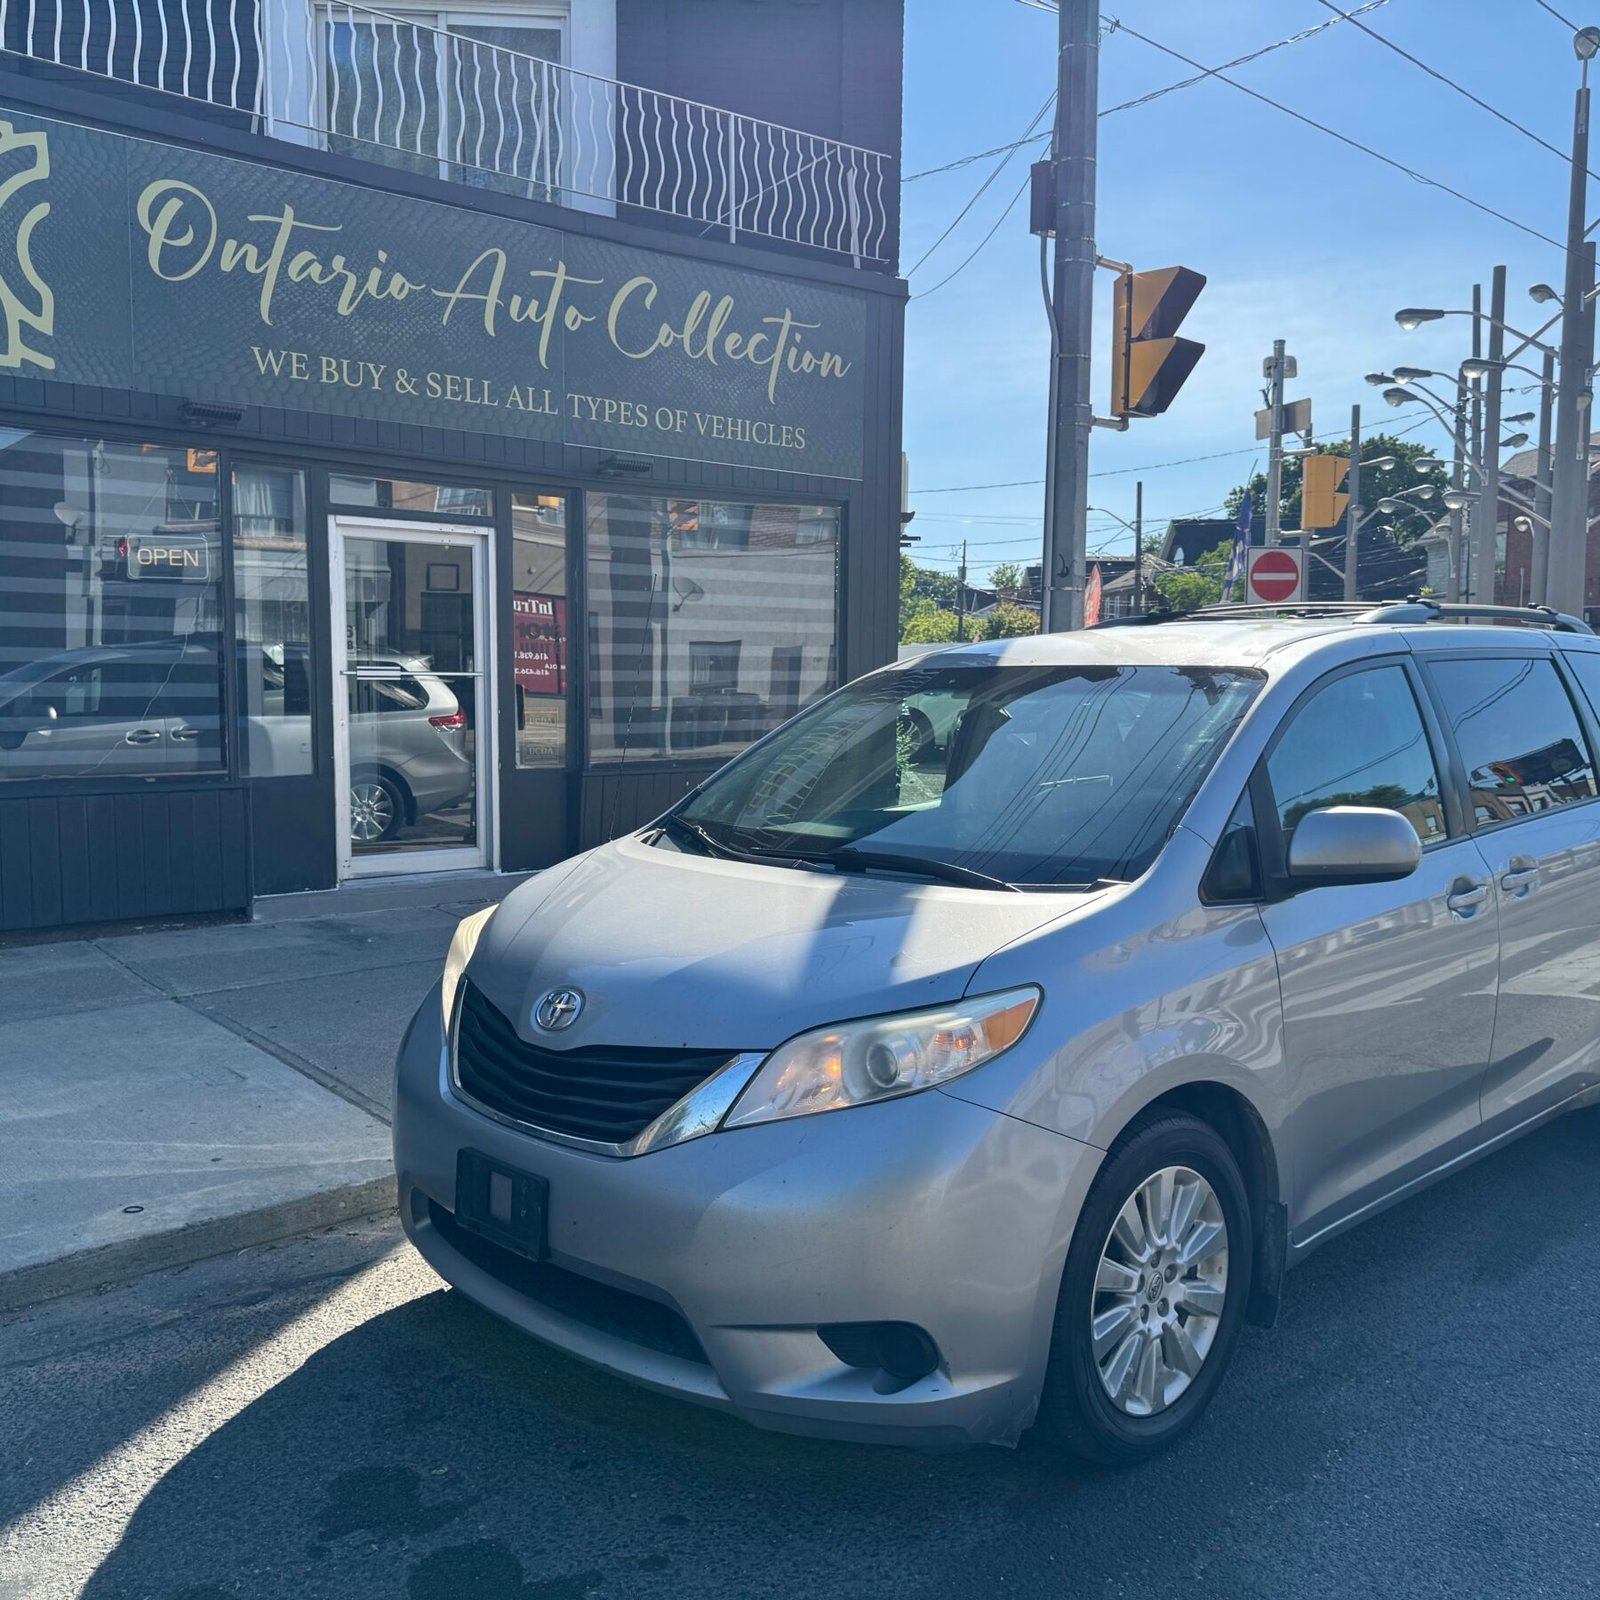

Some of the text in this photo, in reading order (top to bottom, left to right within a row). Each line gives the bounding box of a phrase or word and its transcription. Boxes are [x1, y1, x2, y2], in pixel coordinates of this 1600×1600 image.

[136, 178, 852, 405] Ontario Auto Collection
[250, 346, 807, 449] WE BUY & SELL ALL TYPES OF VEHICLES
[136, 547, 200, 567] OPEN
